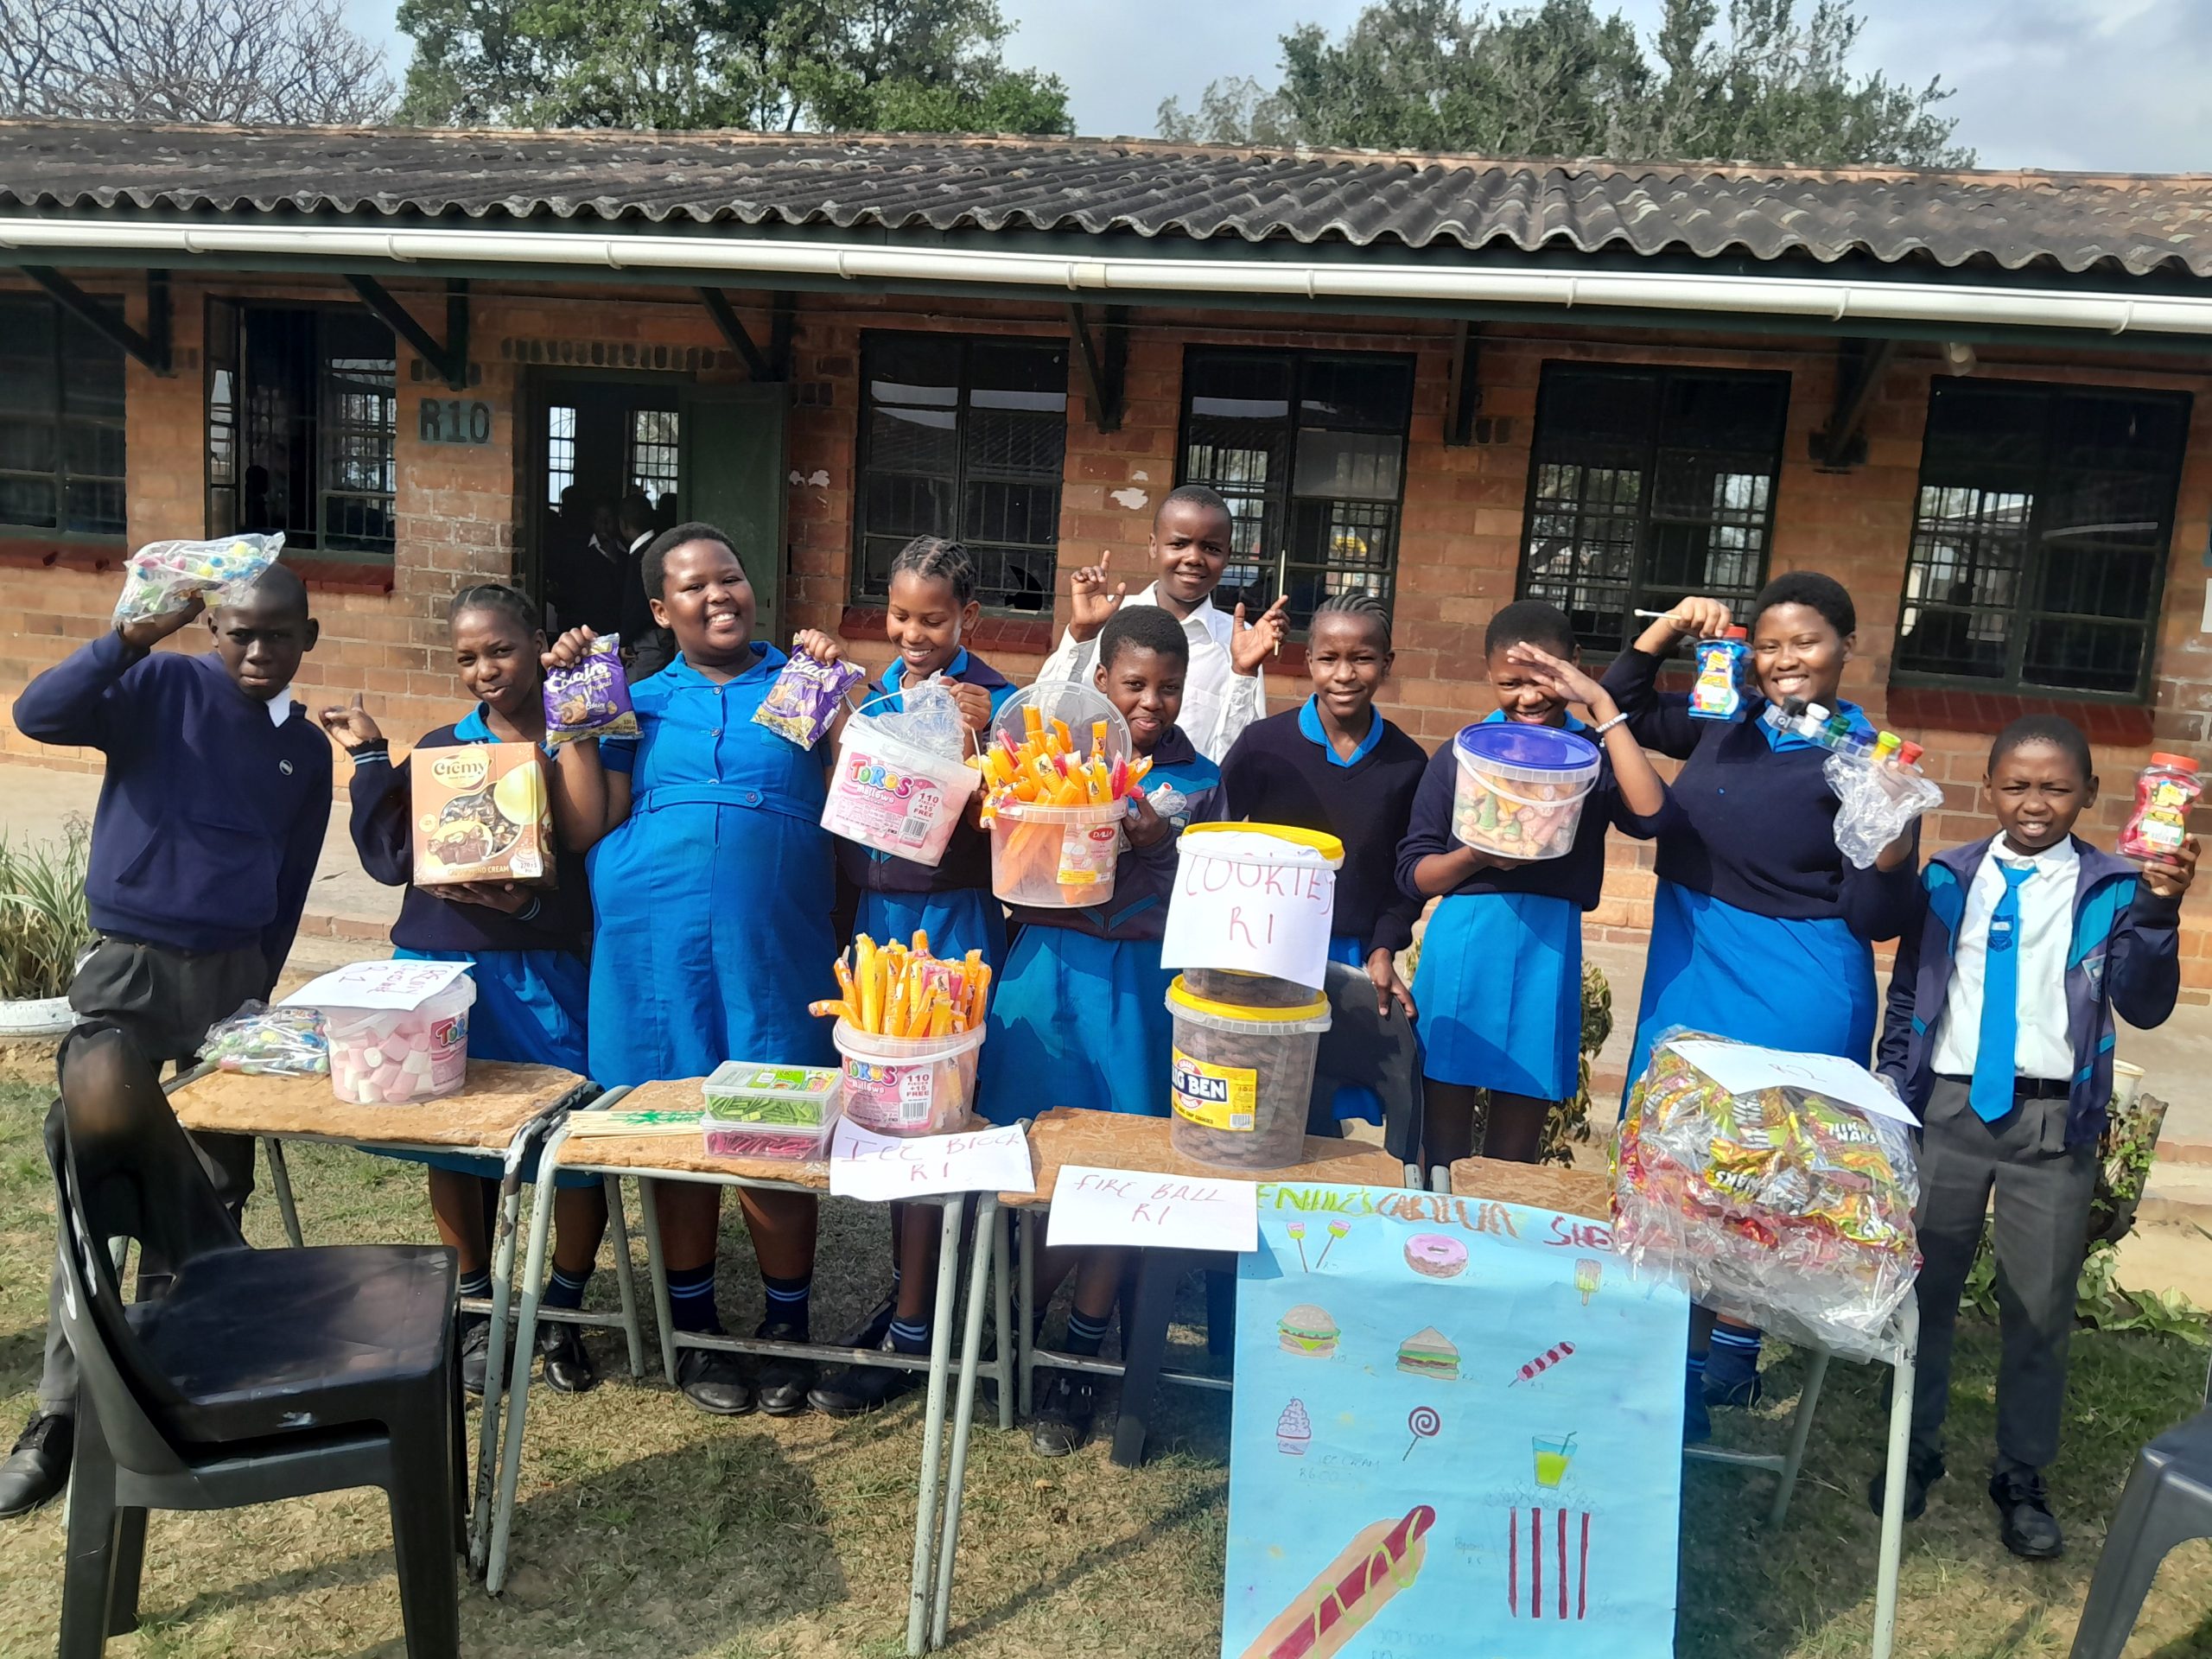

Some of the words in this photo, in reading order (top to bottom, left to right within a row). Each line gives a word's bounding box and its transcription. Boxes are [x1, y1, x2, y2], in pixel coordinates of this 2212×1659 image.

[420, 397, 490, 444] R10
[919, 792, 939, 804] 110
[913, 808, 933, 818] FREE
[906, 1074, 930, 1083] 110
[1187, 1076, 1225, 1100] BEN
[1075, 1175, 1137, 1198] FIRE
[1151, 1183, 1226, 1202] BALL
